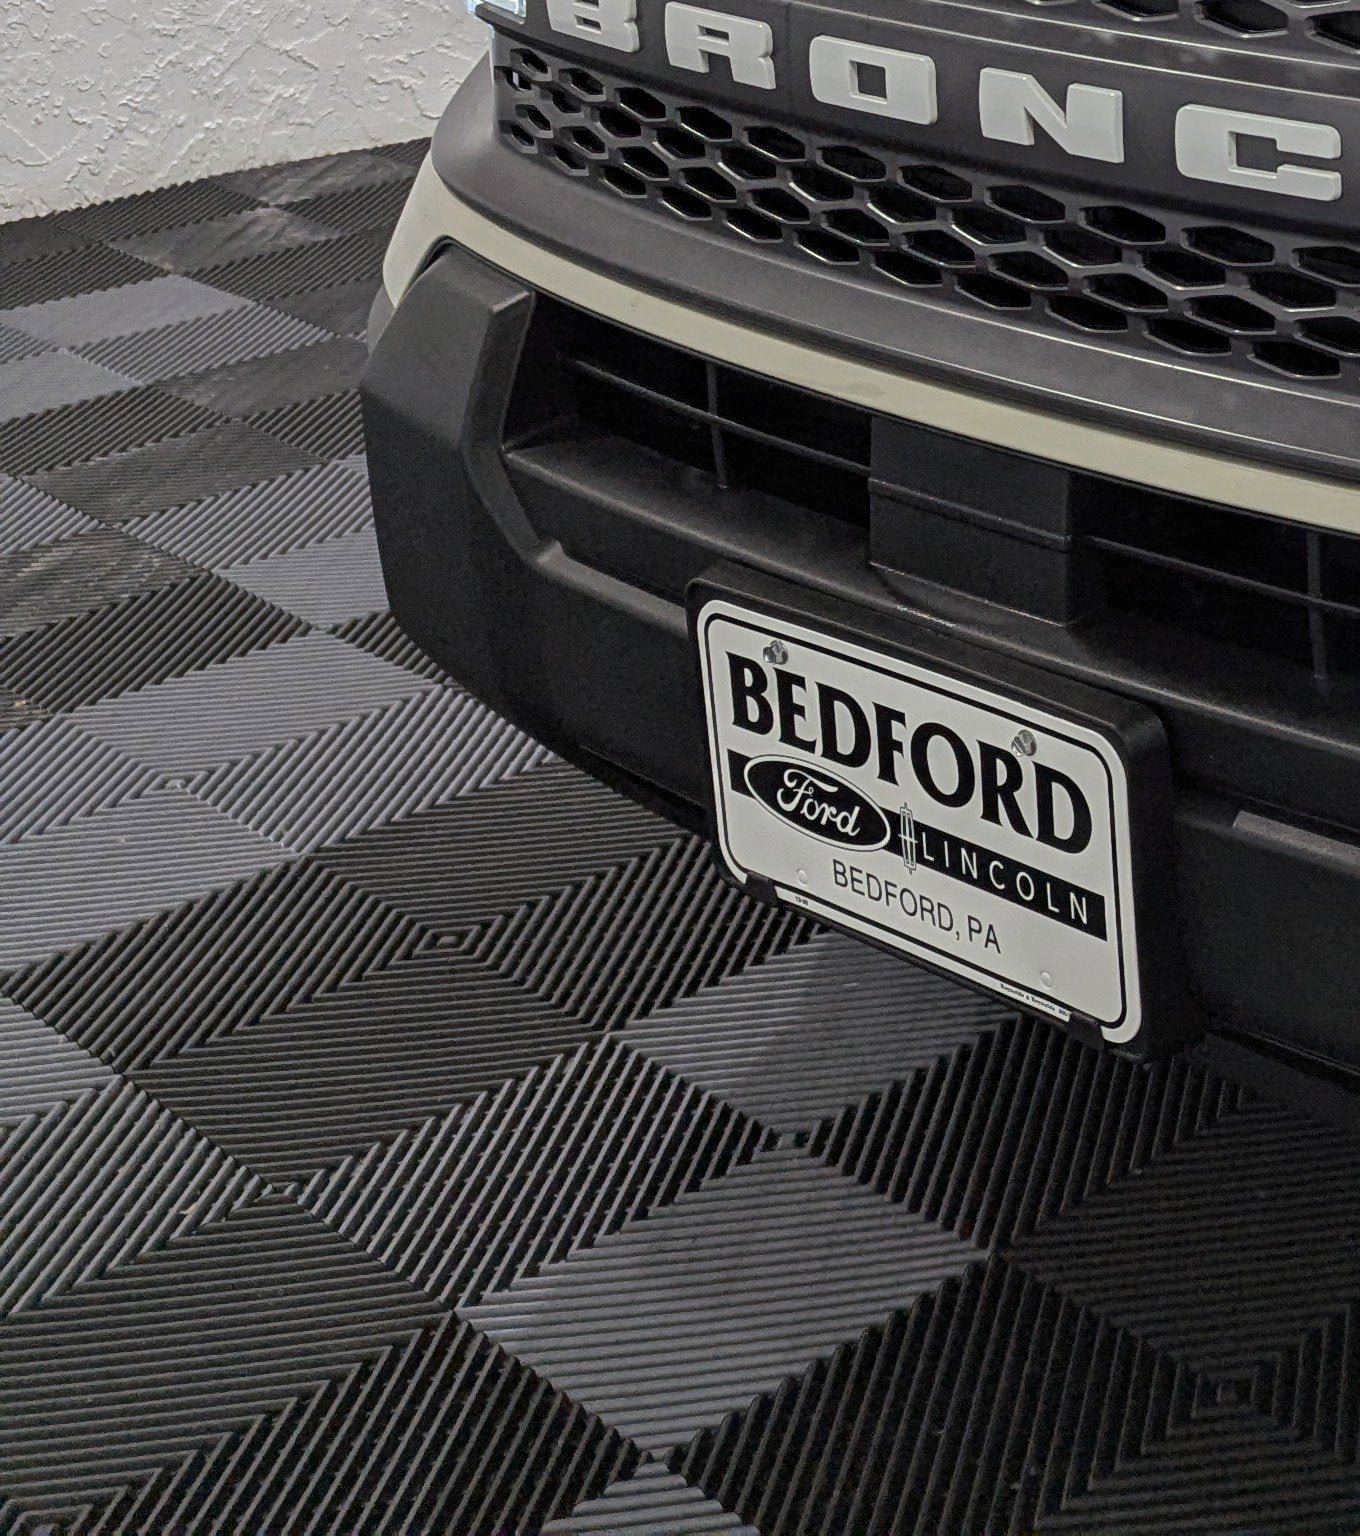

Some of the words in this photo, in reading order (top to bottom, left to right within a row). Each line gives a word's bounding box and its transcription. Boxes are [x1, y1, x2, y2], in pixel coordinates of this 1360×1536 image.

[725, 651, 1092, 854] BEDFORD
[777, 768, 860, 837] Ford
[832, 859, 961, 941] BEDFORD,
[967, 914, 1002, 954] PA
[923, 831, 1088, 925] LINCOLN
